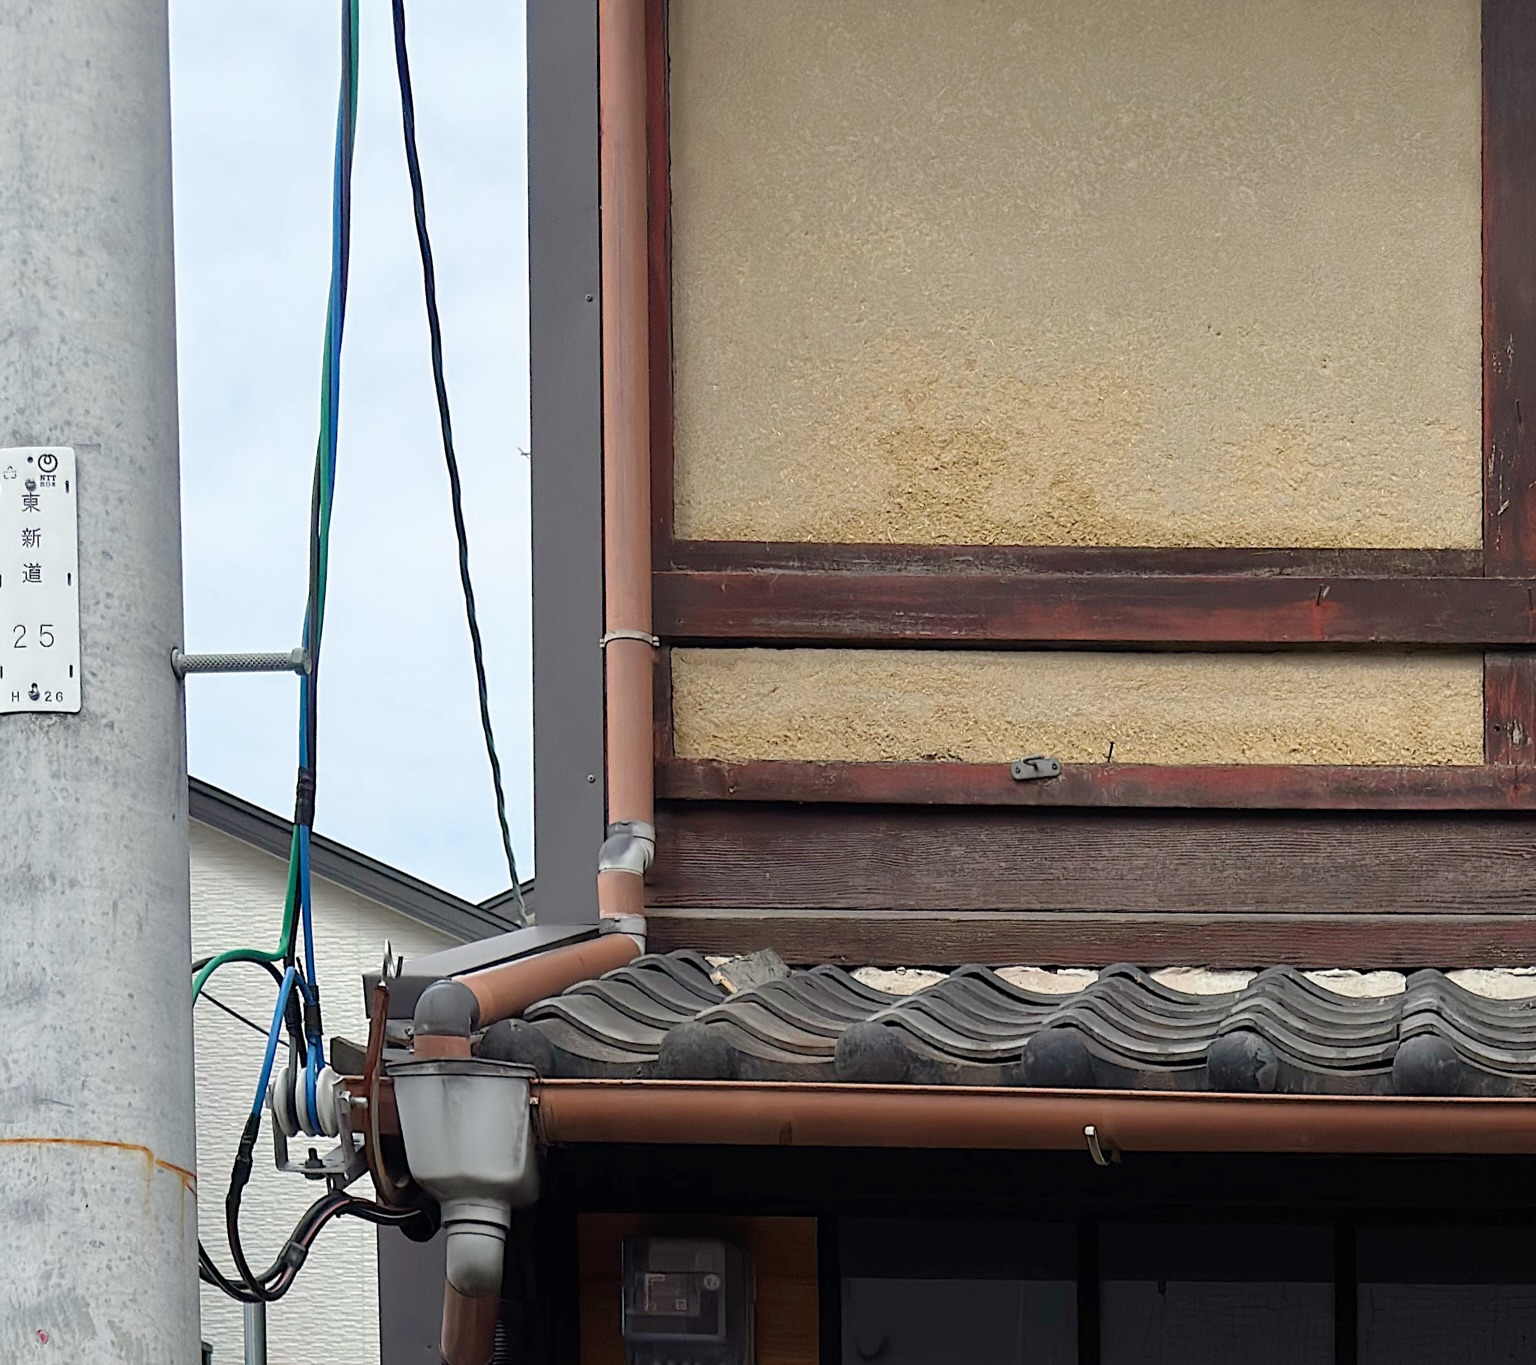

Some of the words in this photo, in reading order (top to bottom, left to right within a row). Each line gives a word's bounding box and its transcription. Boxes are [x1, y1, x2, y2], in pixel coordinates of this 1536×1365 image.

[21, 492, 43, 584] 東新道
[13, 624, 55, 649] 25
[11, 691, 20, 702] H
[44, 691, 64, 702] 26
